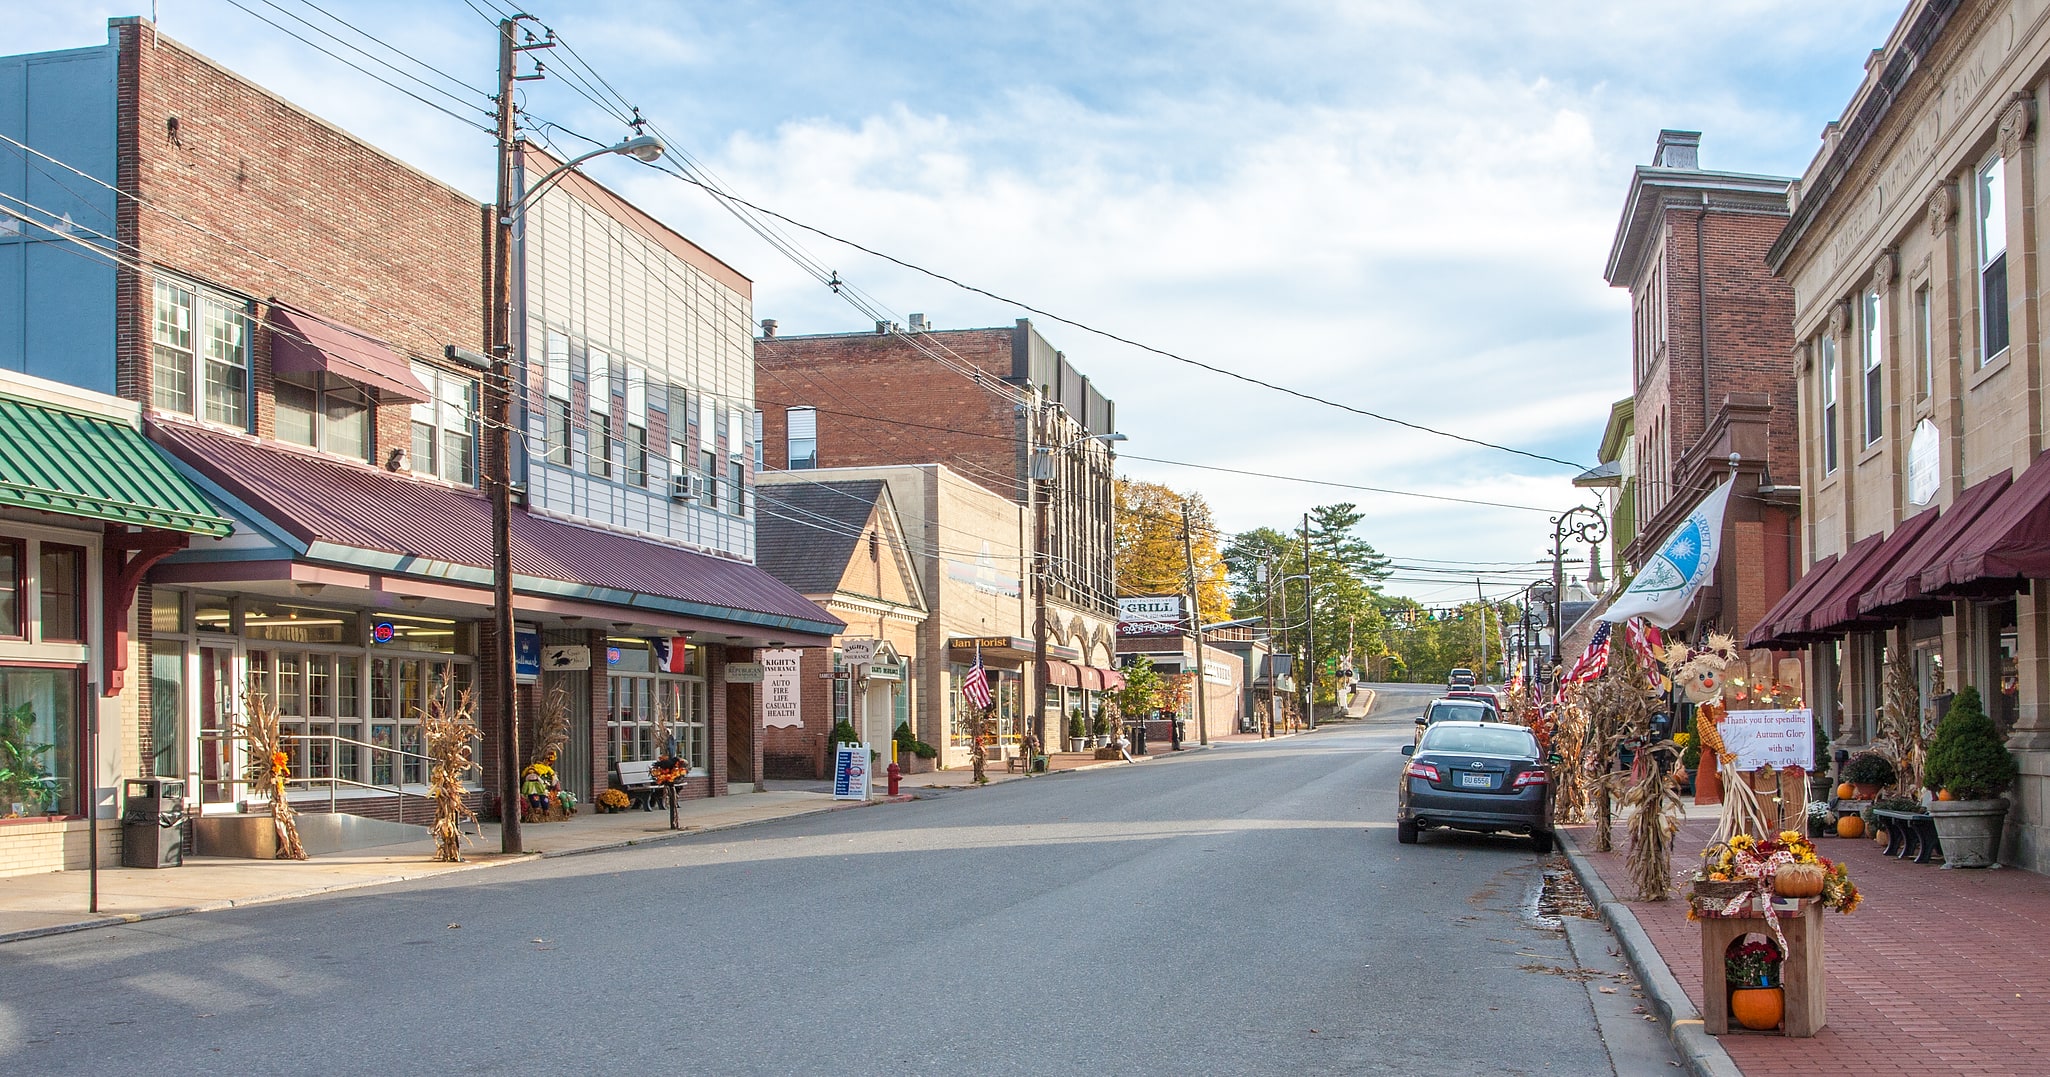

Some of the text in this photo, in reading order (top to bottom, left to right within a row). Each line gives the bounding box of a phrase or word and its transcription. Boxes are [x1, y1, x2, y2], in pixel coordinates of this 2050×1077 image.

[1883, 134, 1929, 199] NATIONAL
[1953, 50, 1986, 114] BANK
[1680, 553, 1711, 599] COUNTY
[1127, 603, 1173, 613] GRILL
[845, 644, 869, 653] KIGHT'S
[952, 639, 971, 648] Jan
[515, 655, 539, 667] allmark
[765, 658, 796, 666] KIGHT'S
[765, 702, 797, 710] CASUALTY
[1727, 714, 1806, 725] Thank you for spending
[1756, 729, 1806, 739] Autumn Glory
[1768, 743, 1795, 753] with us!
[1764, 758, 1778, 766] Town
